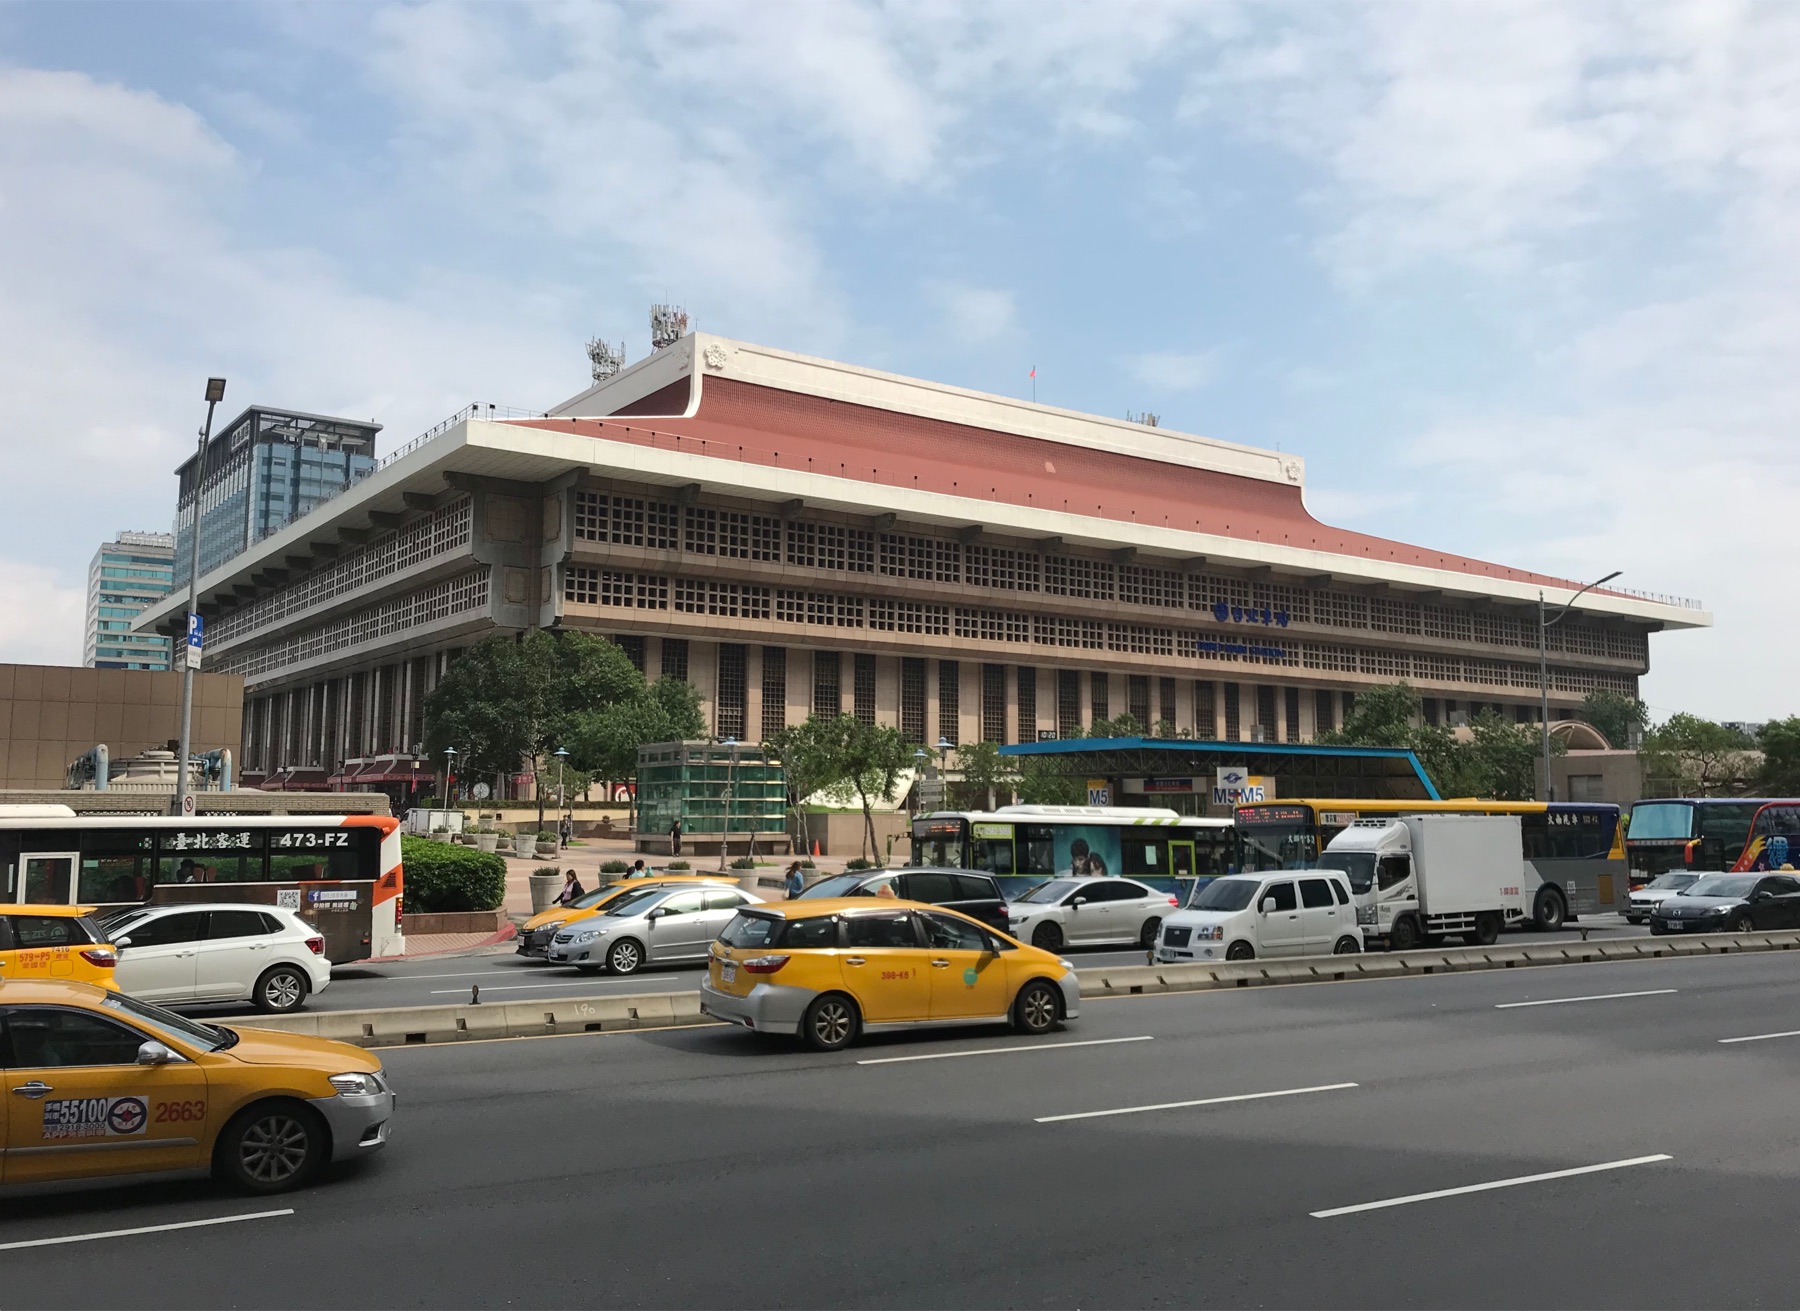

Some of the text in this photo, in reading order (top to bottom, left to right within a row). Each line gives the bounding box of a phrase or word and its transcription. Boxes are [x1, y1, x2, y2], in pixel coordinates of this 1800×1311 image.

[190, 616, 197, 634] P
[1233, 606, 1288, 627] 台北車站
[1090, 789, 1107, 804] M5
[1241, 787, 1263, 803] M5
[172, 832, 348, 850] 臺北客運 473-FZ
[19, 952, 50, 963] 579-P5
[574, 1003, 596, 1016] 190
[60, 1098, 107, 1124] 55100
[155, 1100, 206, 1123] 2663
